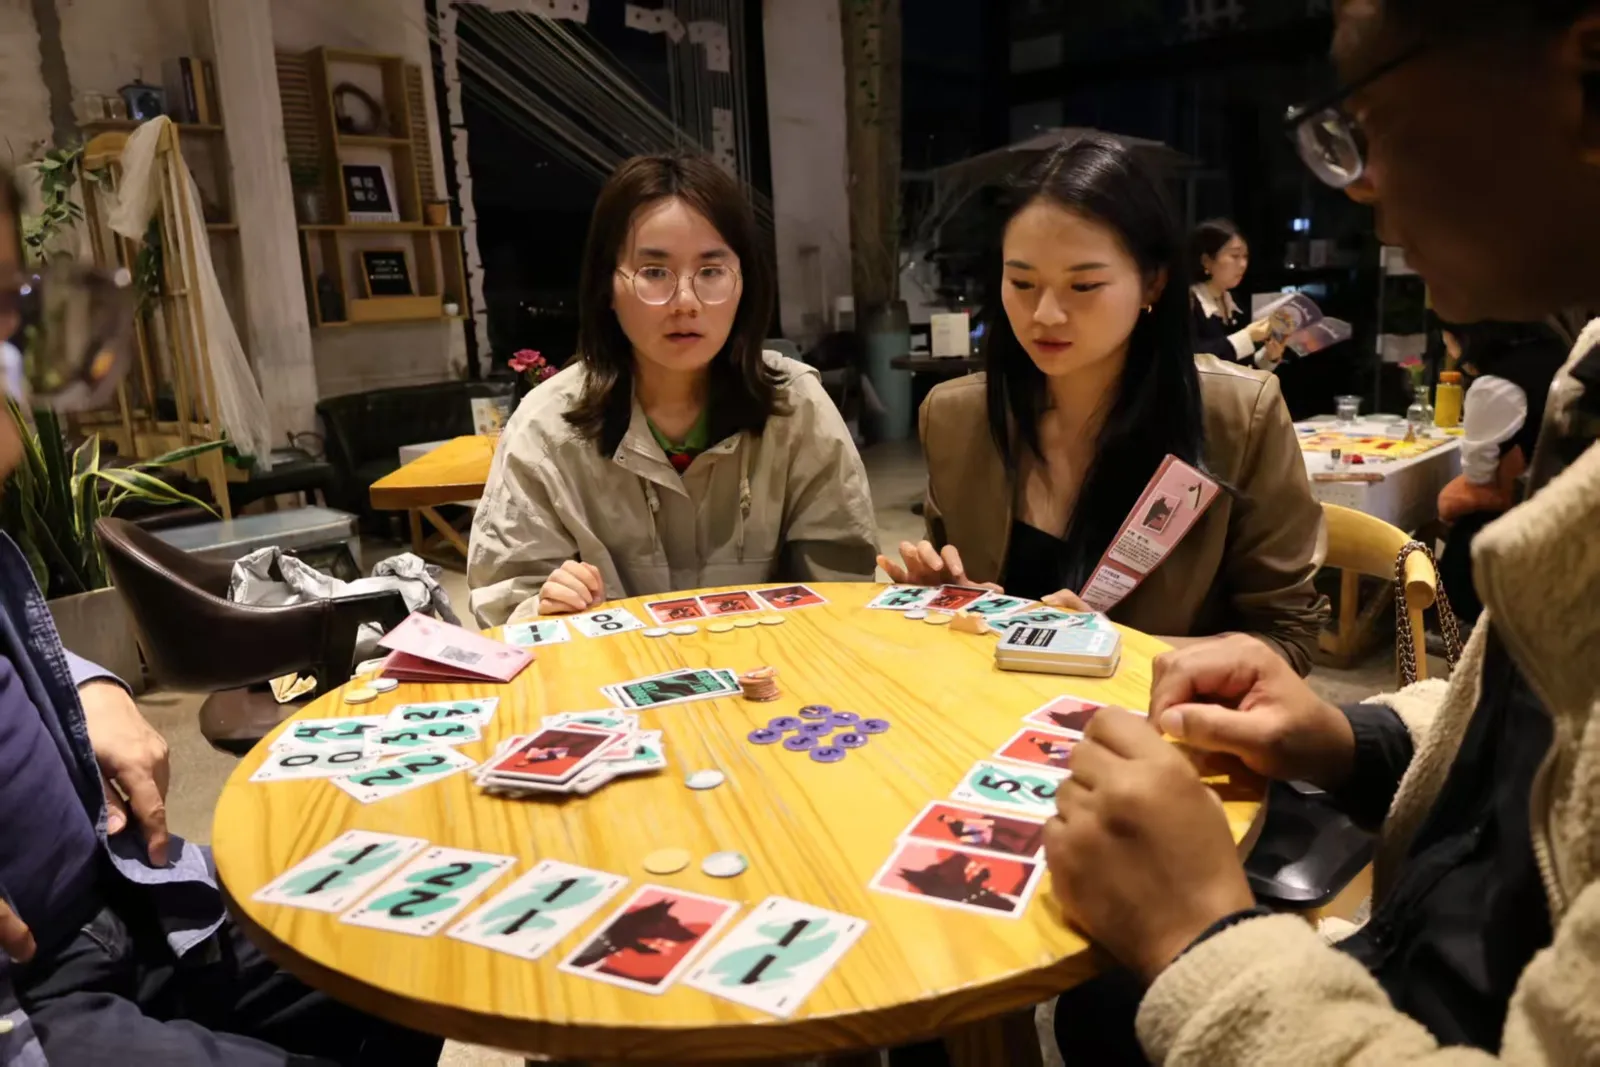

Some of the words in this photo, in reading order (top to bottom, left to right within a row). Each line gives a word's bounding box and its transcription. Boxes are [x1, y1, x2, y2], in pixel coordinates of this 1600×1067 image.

[591, 614, 613, 622] 0
[600, 622, 623, 630] 0
[279, 754, 319, 767] 0
[327, 751, 363, 764] 0
[404, 756, 446, 773] 2
[360, 769, 404, 787] 2
[978, 774, 1022, 794] 5
[346, 843, 381, 865] 1
[305, 870, 344, 895] 1
[424, 862, 473, 887] 2
[541, 878, 579, 903] 1
[388, 889, 441, 918] 2
[502, 908, 540, 935] 1
[776, 919, 811, 948] 1
[739, 953, 778, 985] 1
